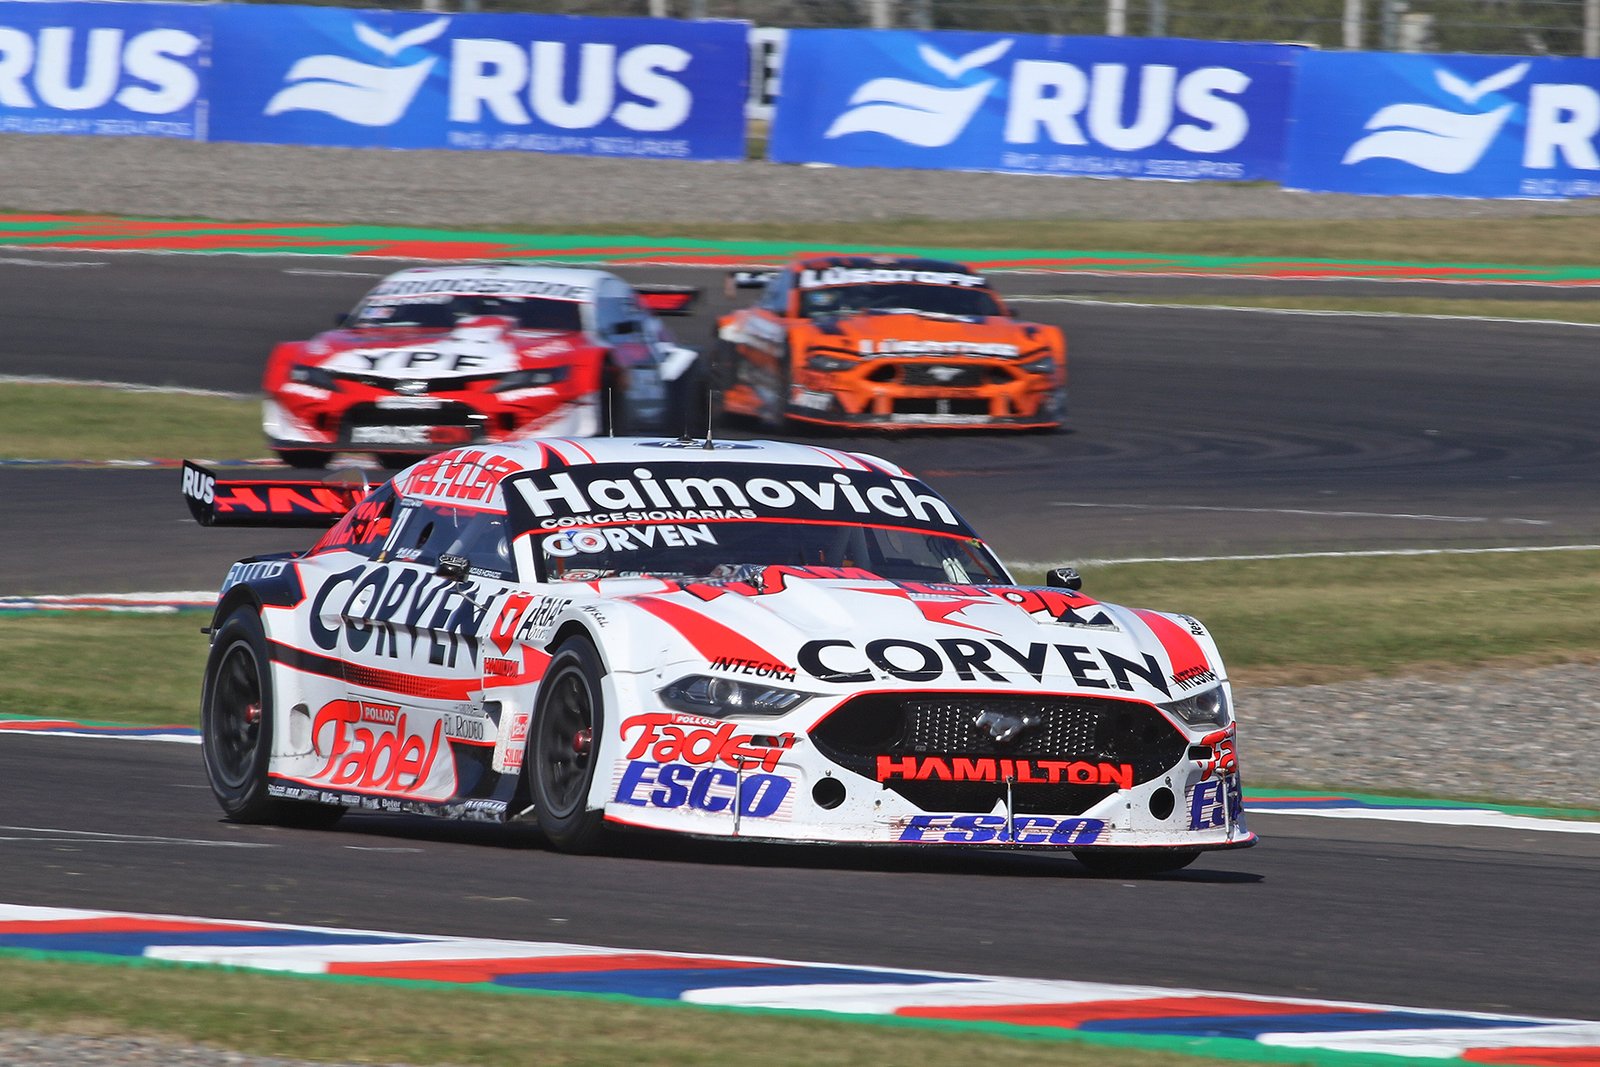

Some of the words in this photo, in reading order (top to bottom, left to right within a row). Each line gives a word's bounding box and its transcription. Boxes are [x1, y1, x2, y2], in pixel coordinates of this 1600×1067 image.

[450, 38, 693, 131] RUS
[1004, 60, 1250, 154] RUS
[361, 350, 487, 373] YPF
[182, 467, 215, 505] RUS
[513, 468, 959, 527] Haimovich
[540, 508, 757, 530] CONCESIONARIAS
[542, 524, 718, 558] CORVEN
[310, 564, 508, 672] CORVEN
[710, 656, 797, 683] INTEGRA
[797, 638, 1172, 701] CORVEN
[1169, 664, 1217, 691] INTEGRA
[365, 706, 396, 722] POLLOS
[444, 713, 454, 736] EL
[456, 715, 484, 740] RODEO
[676, 713, 719, 726] POLLOS
[311, 699, 443, 793] Fadel
[615, 760, 792, 818] ESCO
[876, 755, 1134, 791] HAMILTON
[897, 814, 1105, 845] ESCO
